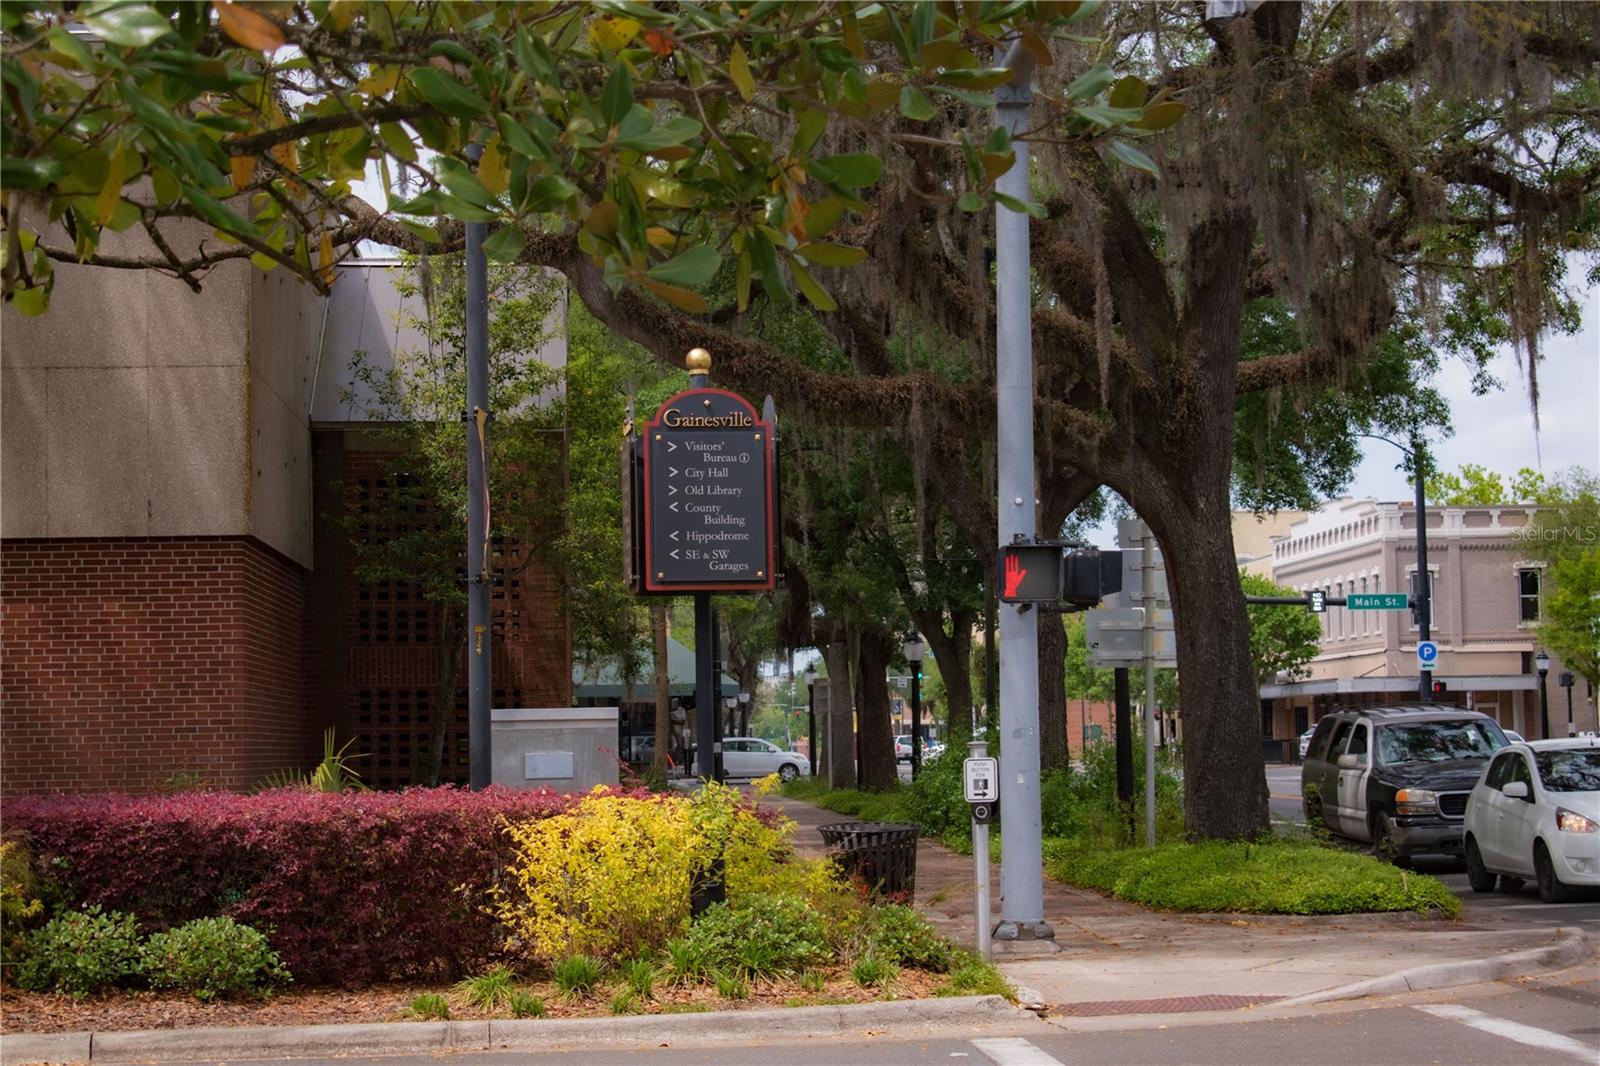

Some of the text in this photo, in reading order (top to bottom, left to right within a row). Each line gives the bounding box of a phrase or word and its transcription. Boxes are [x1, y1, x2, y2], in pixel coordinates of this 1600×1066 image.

[663, 408, 753, 427] Gainesville
[703, 453, 737, 462] Bureau
[684, 467, 728, 480] City Hall
[684, 485, 743, 498] Old Library
[684, 502, 722, 515] County
[704, 514, 746, 527] Building
[686, 531, 750, 543] Hippodrome
[685, 549, 701, 559] SE
[712, 549, 730, 559] SW
[709, 560, 749, 573] Garages
[1354, 597, 1400, 606] Main St.
[1424, 647, 1433, 658] P
